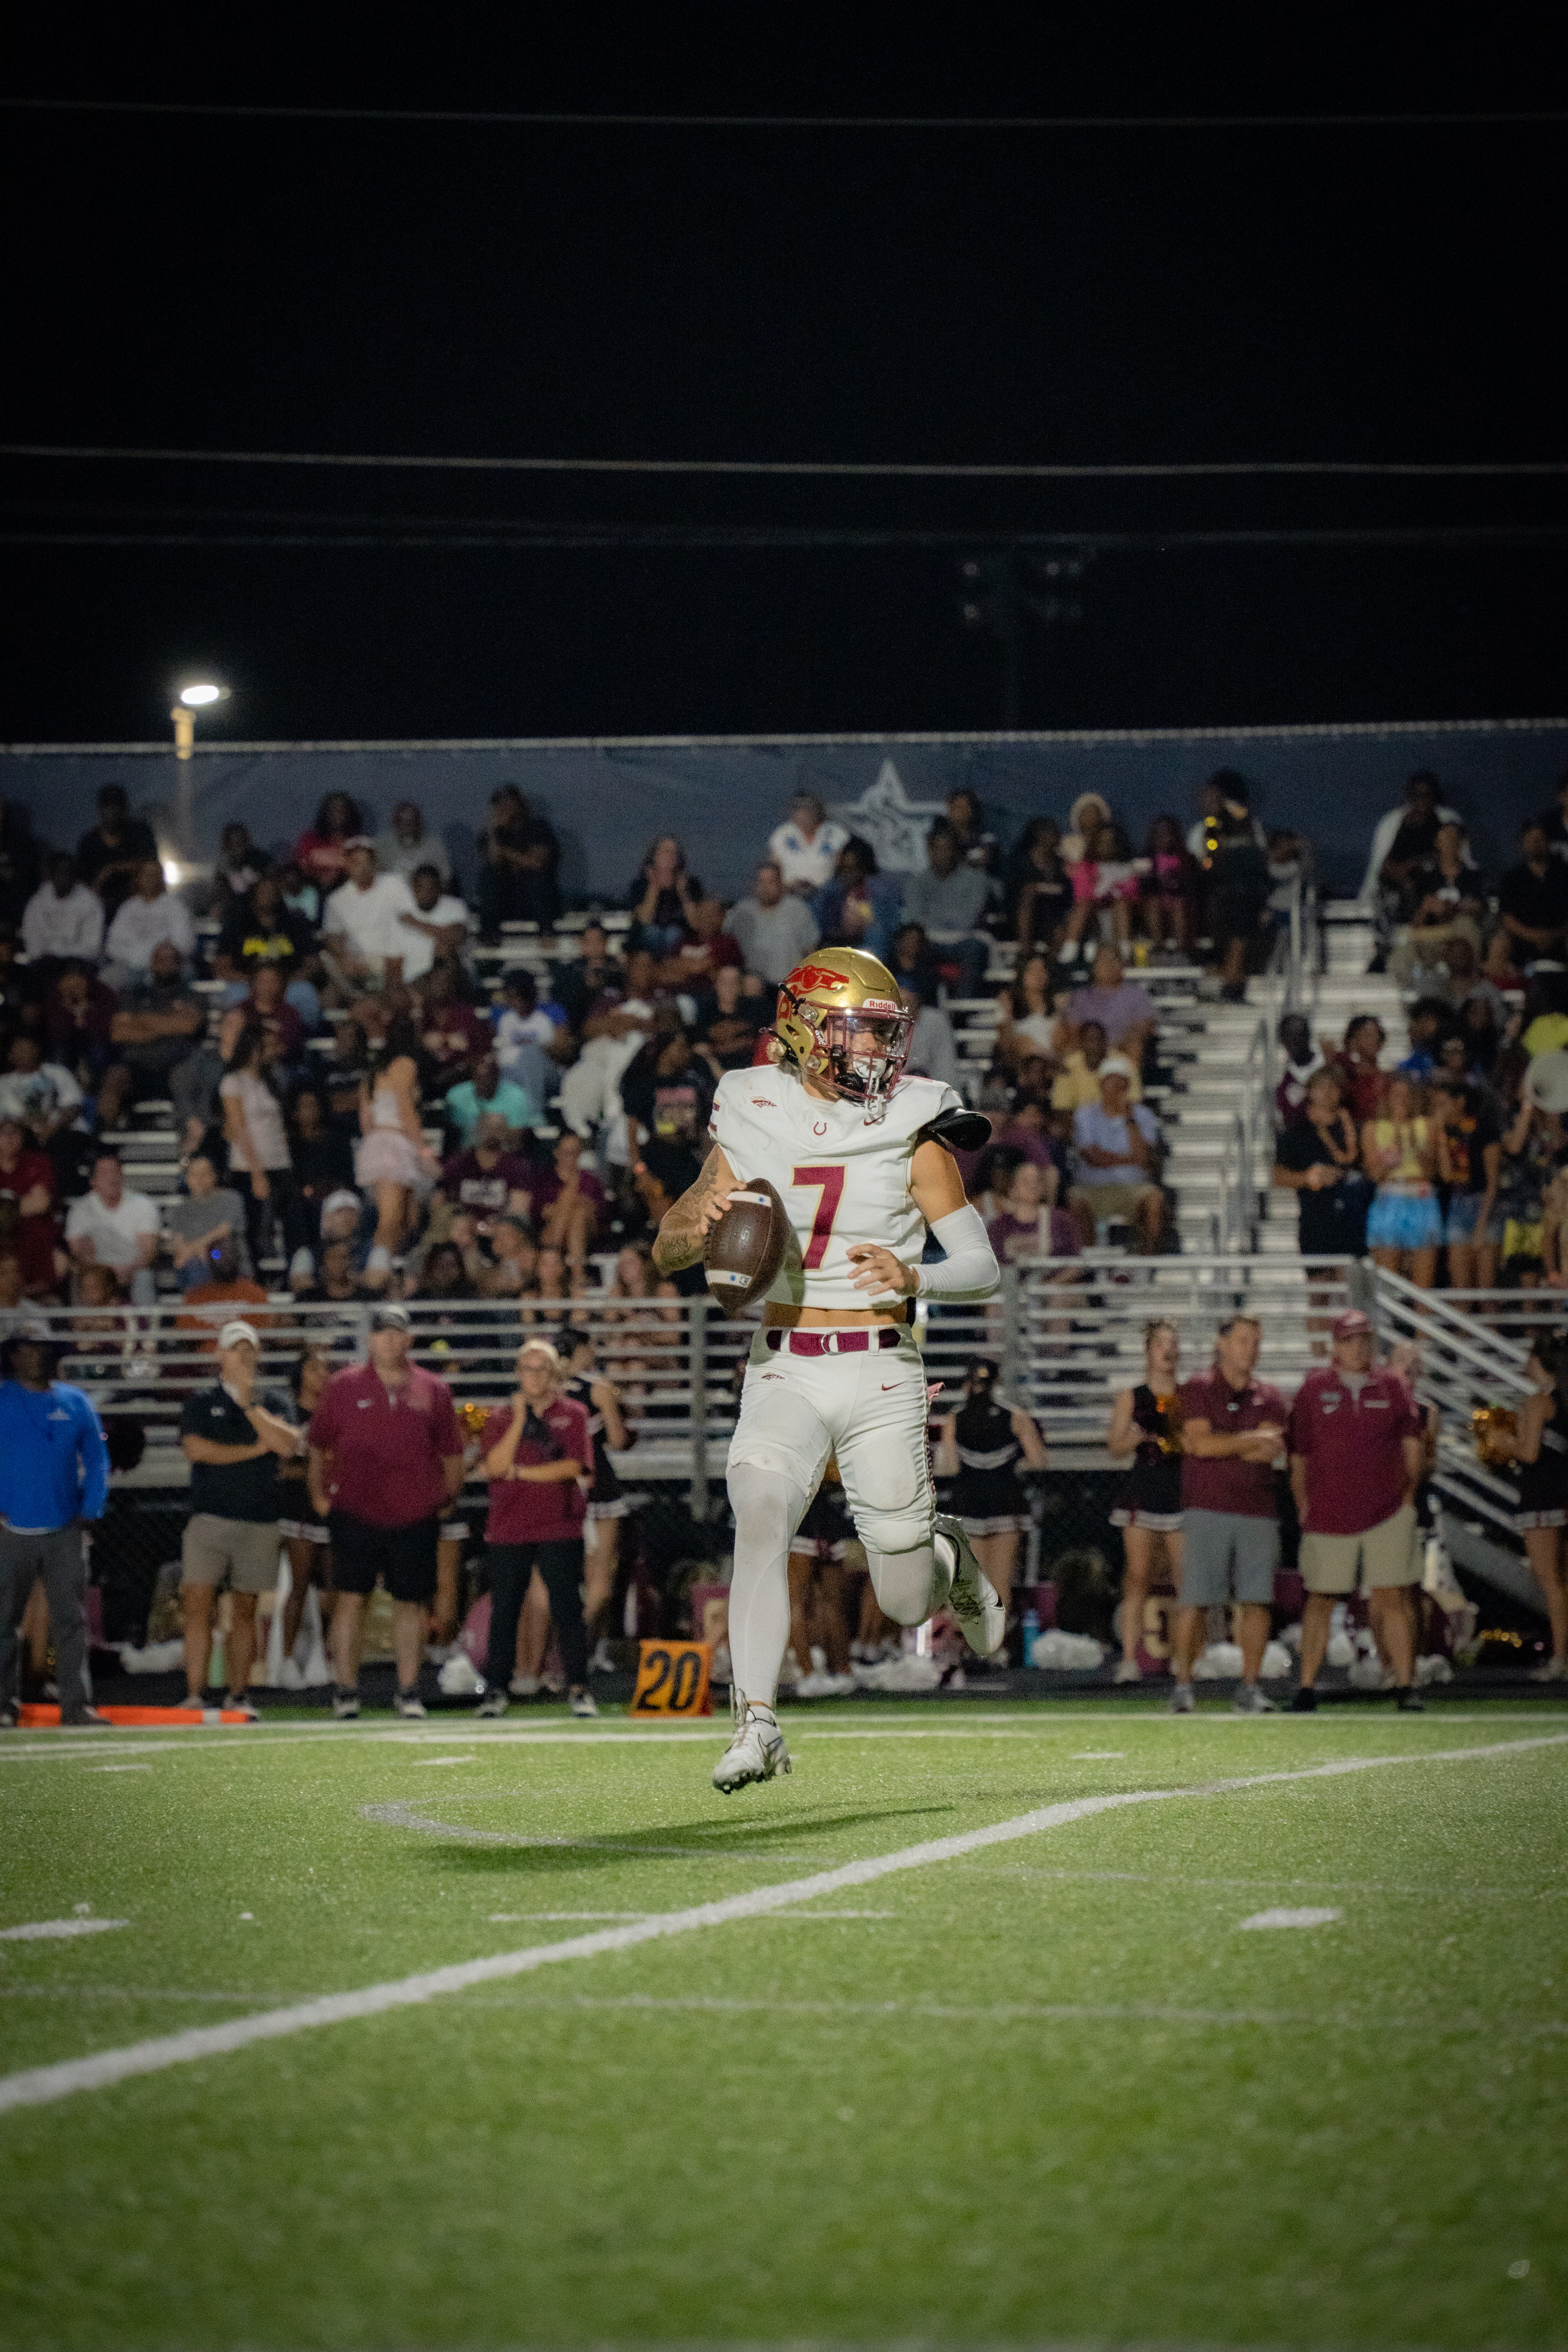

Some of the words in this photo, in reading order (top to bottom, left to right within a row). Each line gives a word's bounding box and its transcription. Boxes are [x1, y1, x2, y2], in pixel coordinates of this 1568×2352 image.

[869, 1000, 896, 1010] Riddell
[789, 1164, 848, 1271] 7
[636, 1651, 701, 1711] 20
